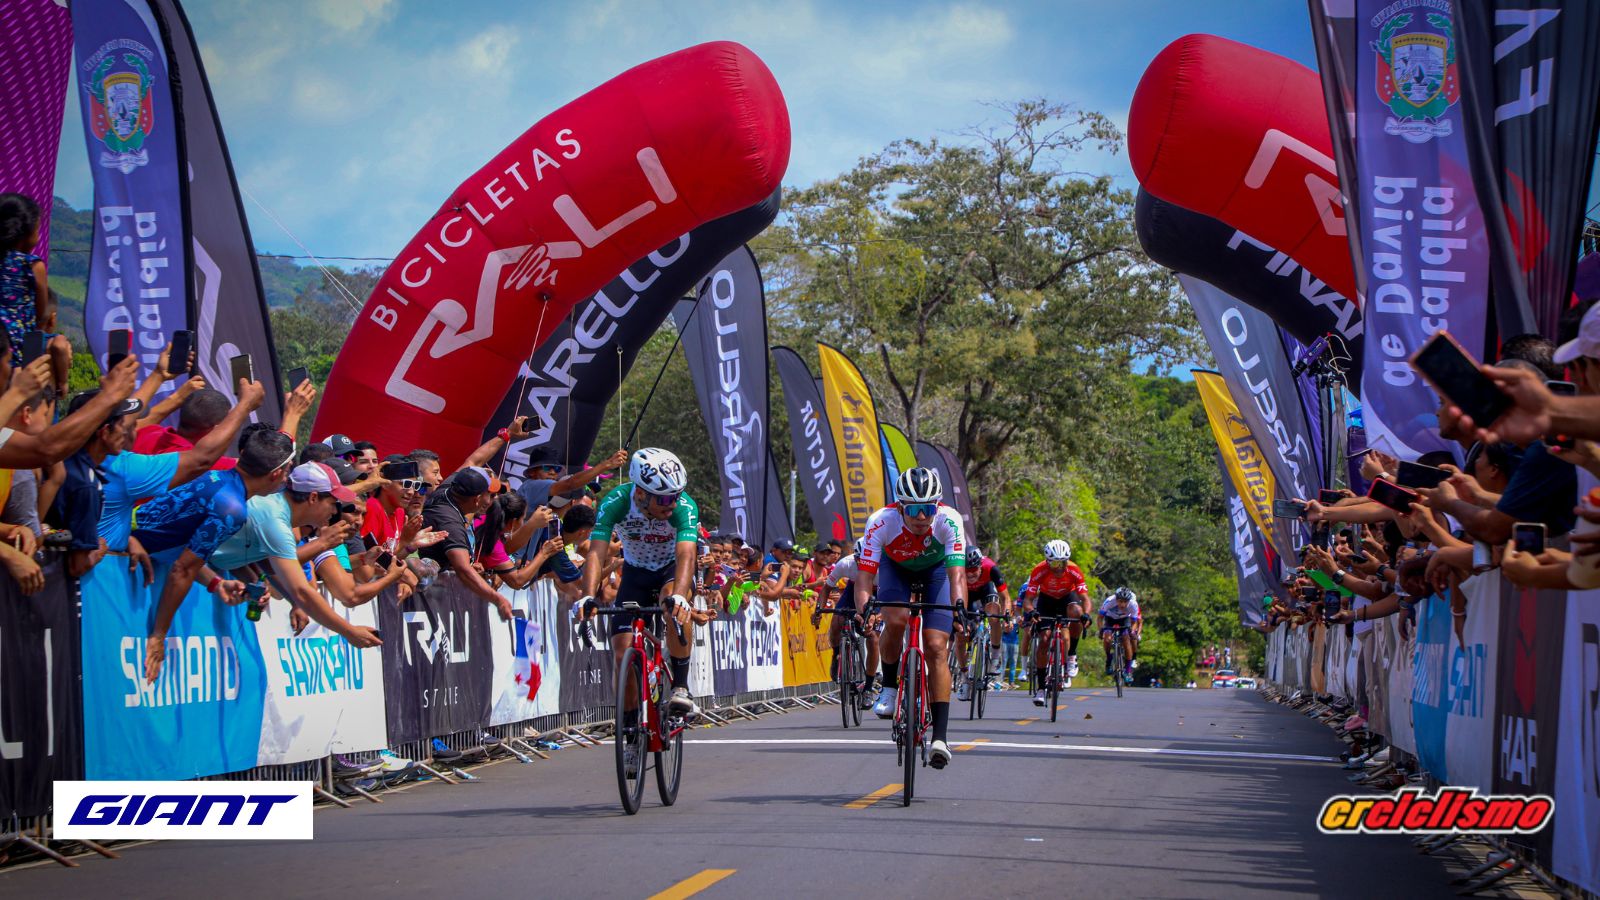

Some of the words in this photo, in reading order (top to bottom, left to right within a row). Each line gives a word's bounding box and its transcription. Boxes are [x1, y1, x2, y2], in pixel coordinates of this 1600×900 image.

[370, 128, 582, 332] BICICLETAS
[641, 462, 659, 482] 32
[120, 636, 240, 708] SHIMANO
[277, 634, 364, 697] SHIMANO
